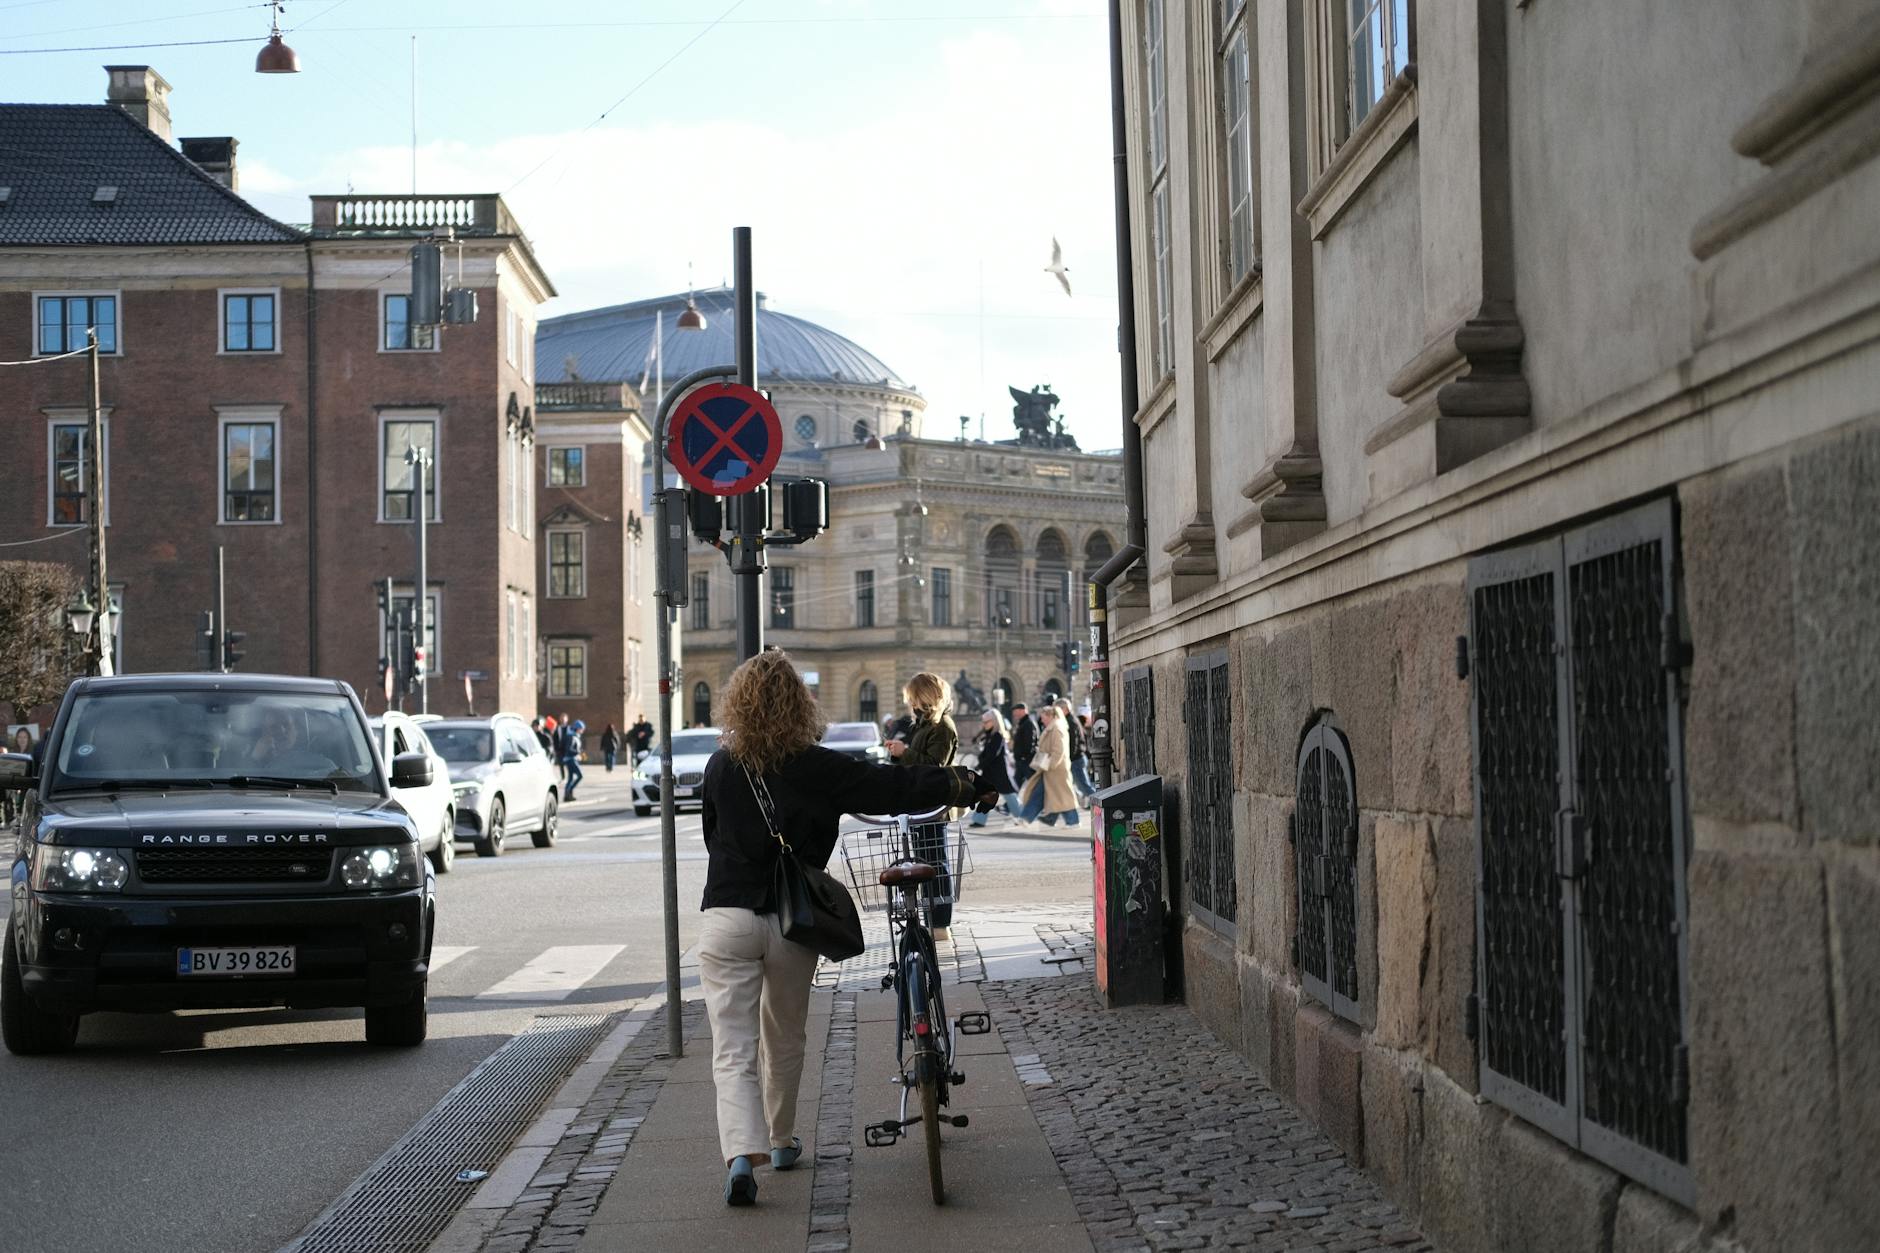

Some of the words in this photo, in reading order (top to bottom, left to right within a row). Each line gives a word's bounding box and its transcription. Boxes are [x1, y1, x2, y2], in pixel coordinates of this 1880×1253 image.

[142, 835, 228, 843] RANGE
[246, 834, 327, 842] ROVER
[193, 952, 221, 971] BV
[226, 952, 250, 971] 39
[255, 950, 292, 970] 826
